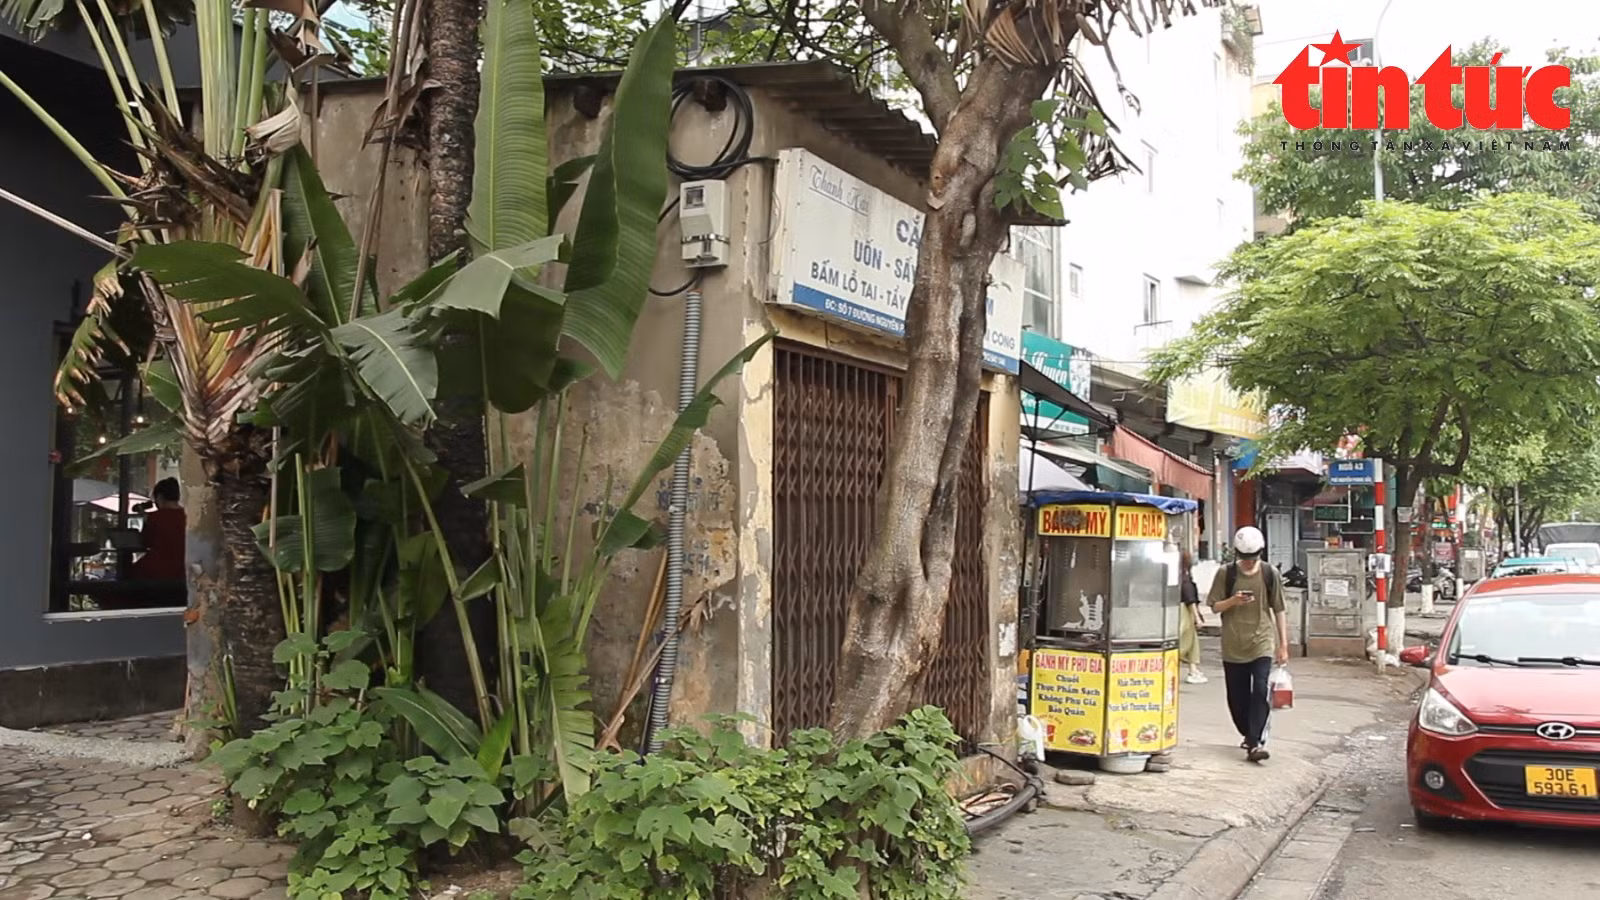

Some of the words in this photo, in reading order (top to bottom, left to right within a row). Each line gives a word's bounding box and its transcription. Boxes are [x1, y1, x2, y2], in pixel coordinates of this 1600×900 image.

[896, 214, 921, 250] CẮ
[854, 239, 882, 270] UỐN
[811, 259, 839, 287] BẤM
[843, 269, 858, 293] LỖ
[861, 280, 877, 300] TAI
[886, 285, 906, 310] TẨY
[1119, 513, 1139, 536] TAM
[1141, 510, 1163, 537] GIÁC
[1545, 768, 1576, 782] 30E
